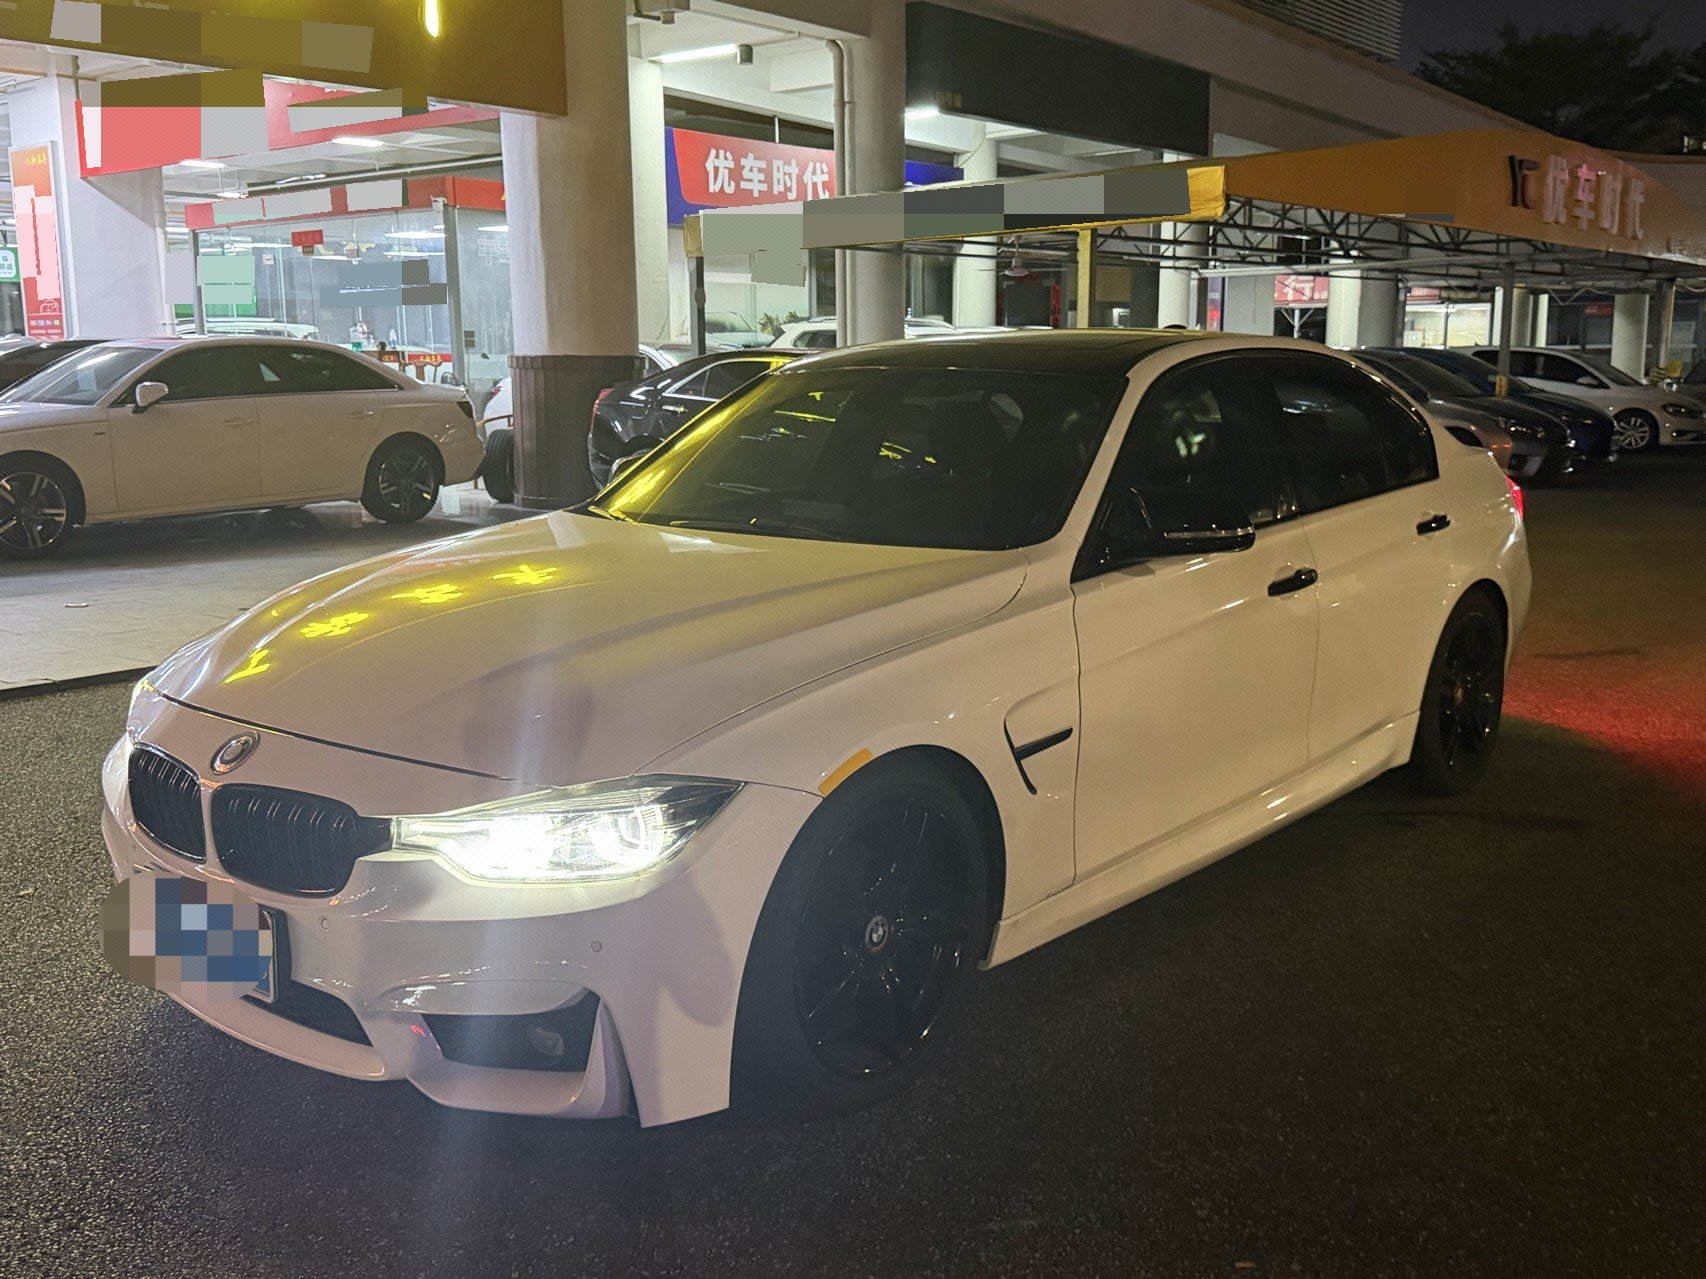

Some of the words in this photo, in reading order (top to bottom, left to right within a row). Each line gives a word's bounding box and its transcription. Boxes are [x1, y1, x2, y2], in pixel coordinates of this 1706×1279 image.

[706, 148, 829, 201] 优车时代
[1543, 155, 1645, 241] 优车时代
